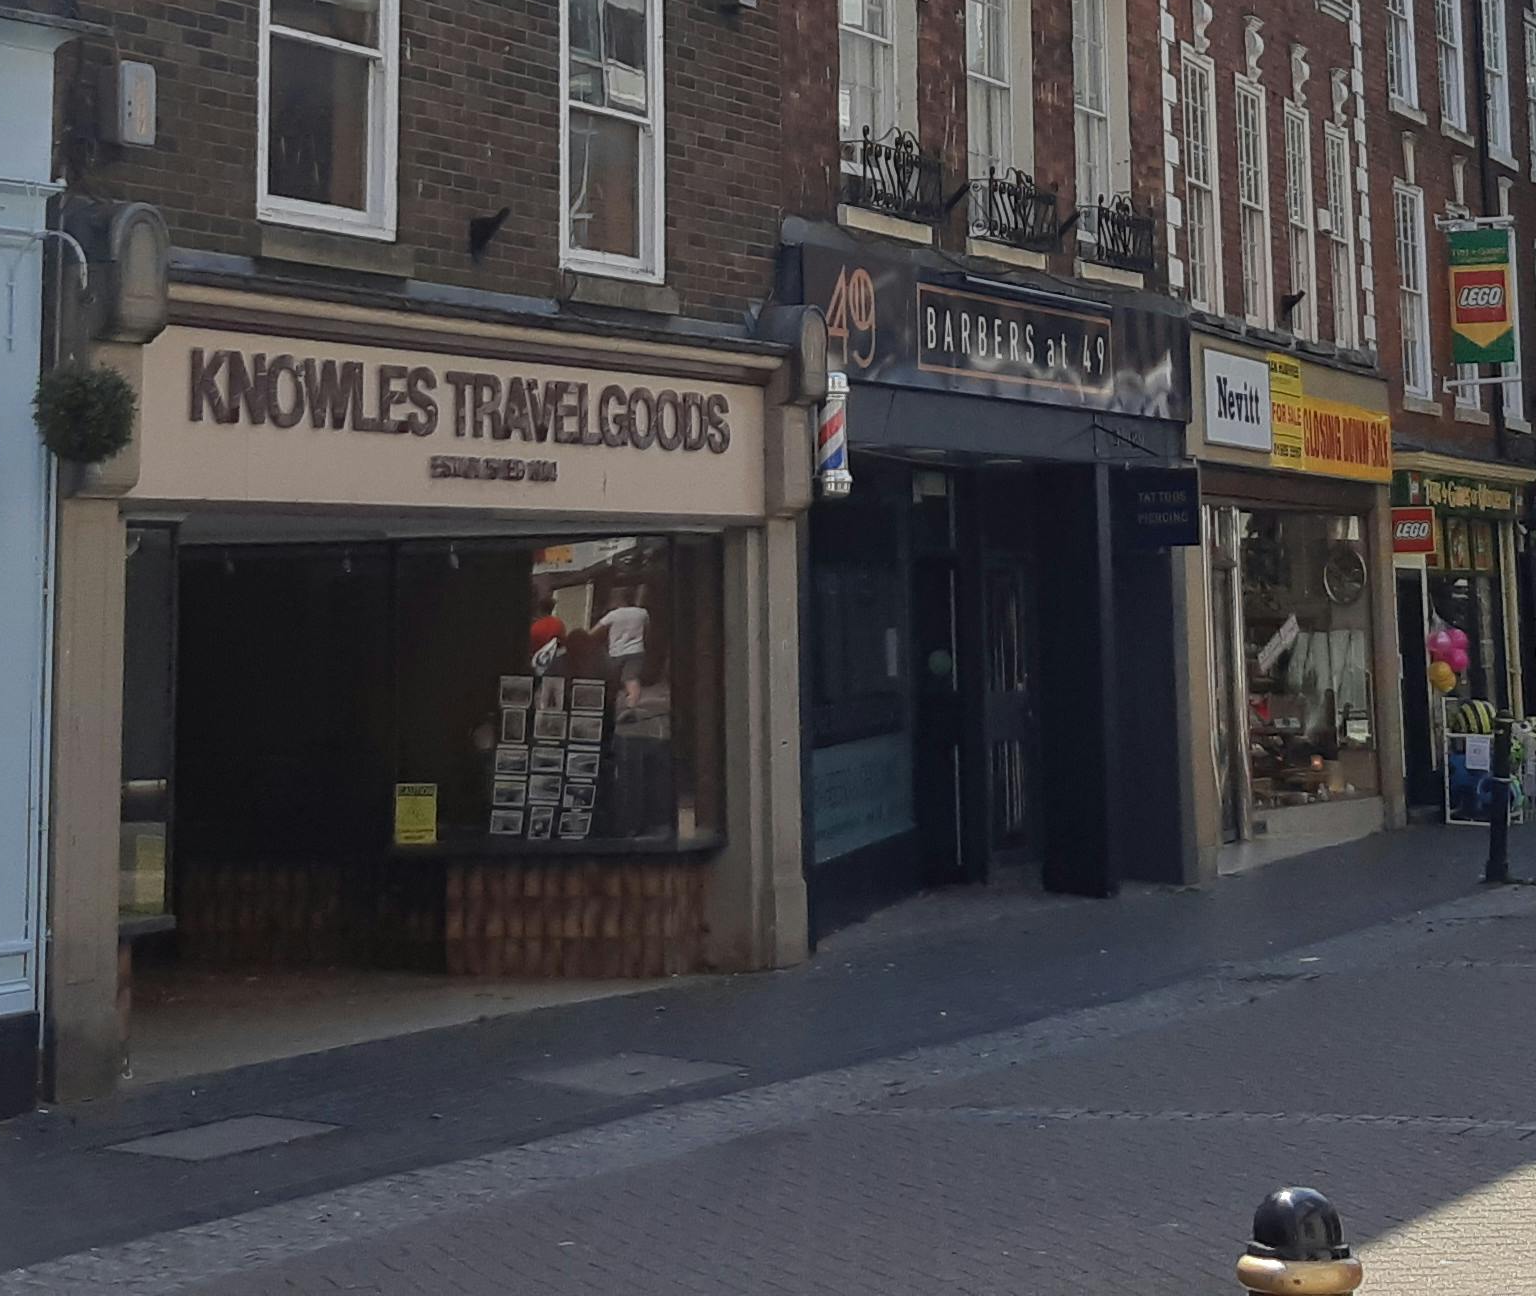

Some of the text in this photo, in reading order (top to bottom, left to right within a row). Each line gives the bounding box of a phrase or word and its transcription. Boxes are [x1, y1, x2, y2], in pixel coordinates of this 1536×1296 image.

[825, 264, 876, 369] 49
[1459, 285, 1502, 307] LEGO
[926, 306, 1106, 376] BARBERS at 49
[188, 347, 438, 437] KNOWLES
[1215, 375, 1260, 426] Nevitt
[1271, 401, 1286, 423] FOR
[1303, 408, 1342, 462] CLOSING
[1395, 521, 1431, 540] LEGO
